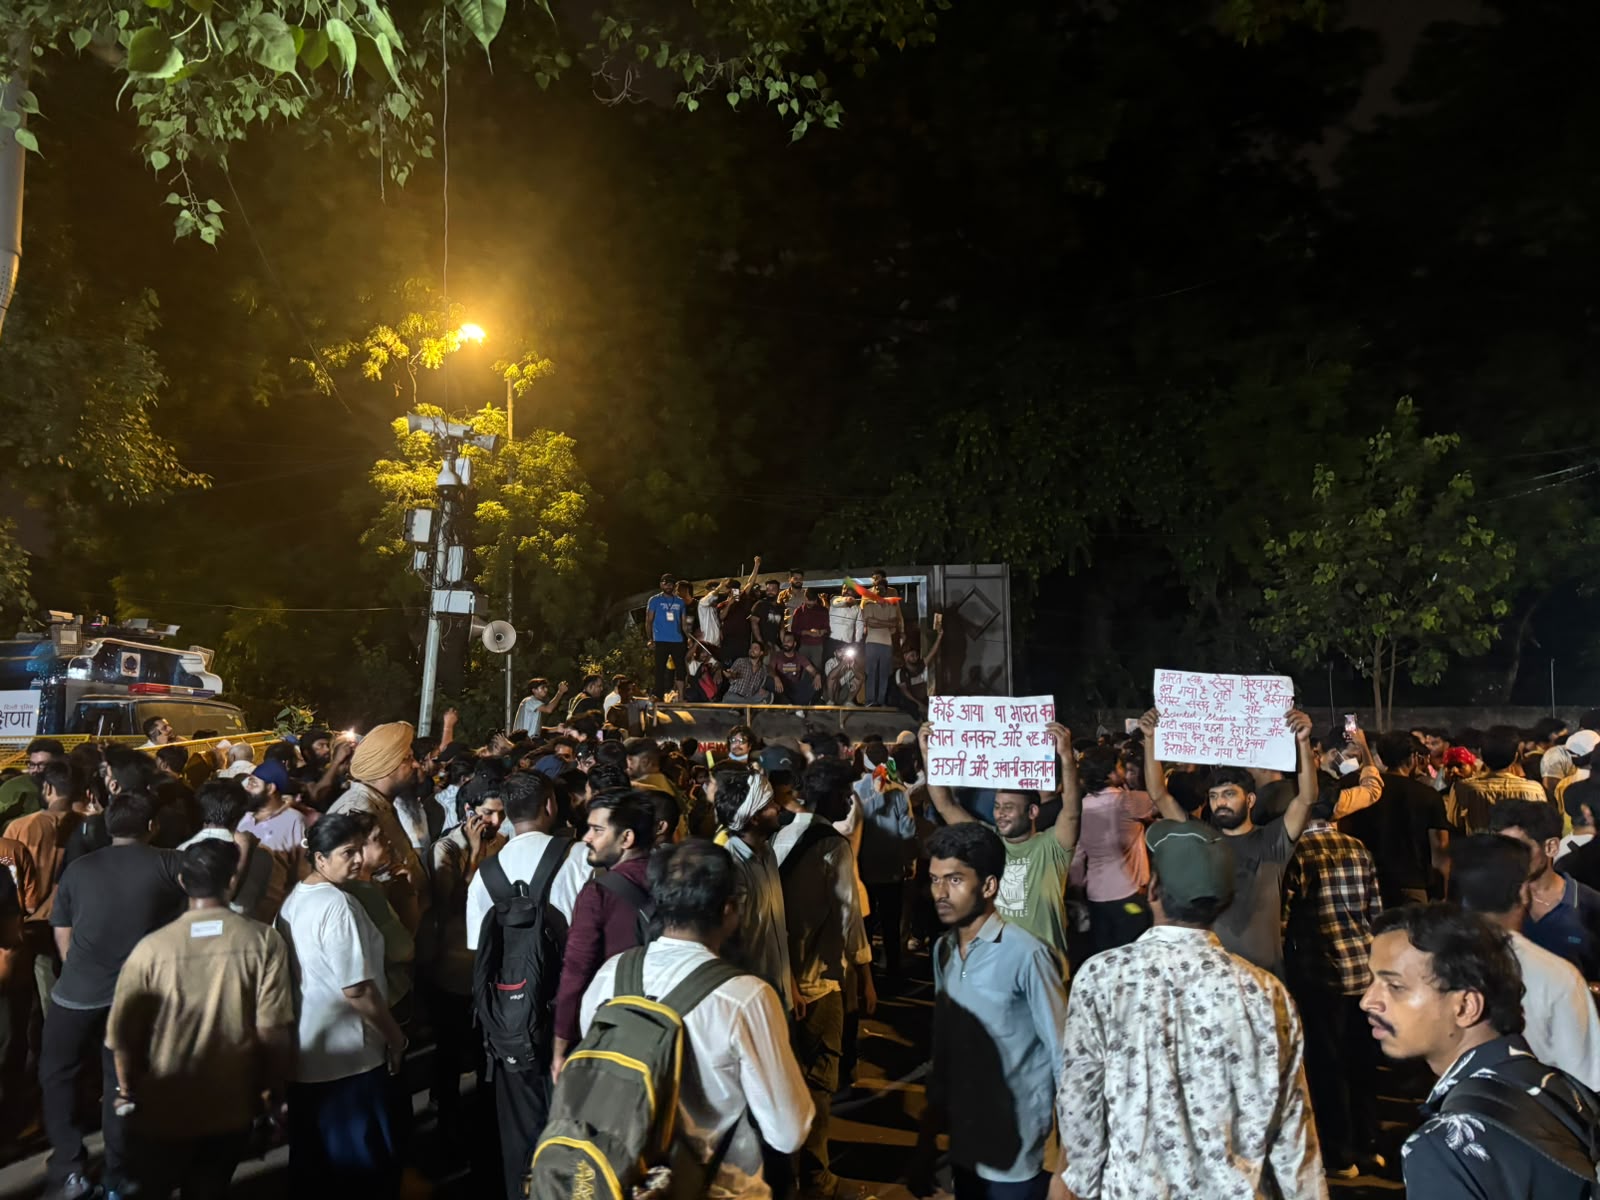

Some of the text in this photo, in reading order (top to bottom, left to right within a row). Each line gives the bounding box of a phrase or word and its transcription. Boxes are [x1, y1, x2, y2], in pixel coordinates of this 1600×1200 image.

[1160, 672, 1182, 684] भारत
[1178, 686, 1197, 699] गया
[1200, 685, 1209, 700] है
[957, 704, 984, 722] आया
[1010, 704, 1038, 723] भारत
[1040, 704, 1055, 721] का
[1240, 701, 1264, 714] और
[930, 729, 955, 746] लाल
[961, 730, 997, 748] बनकर
[999, 723, 1023, 747] और
[1026, 731, 1039, 747] रह
[1215, 747, 1233, 759] गया
[931, 750, 967, 776] अडानी
[969, 754, 989, 780] और
[1020, 761, 1034, 777] का
[1034, 760, 1056, 777] दलाल
